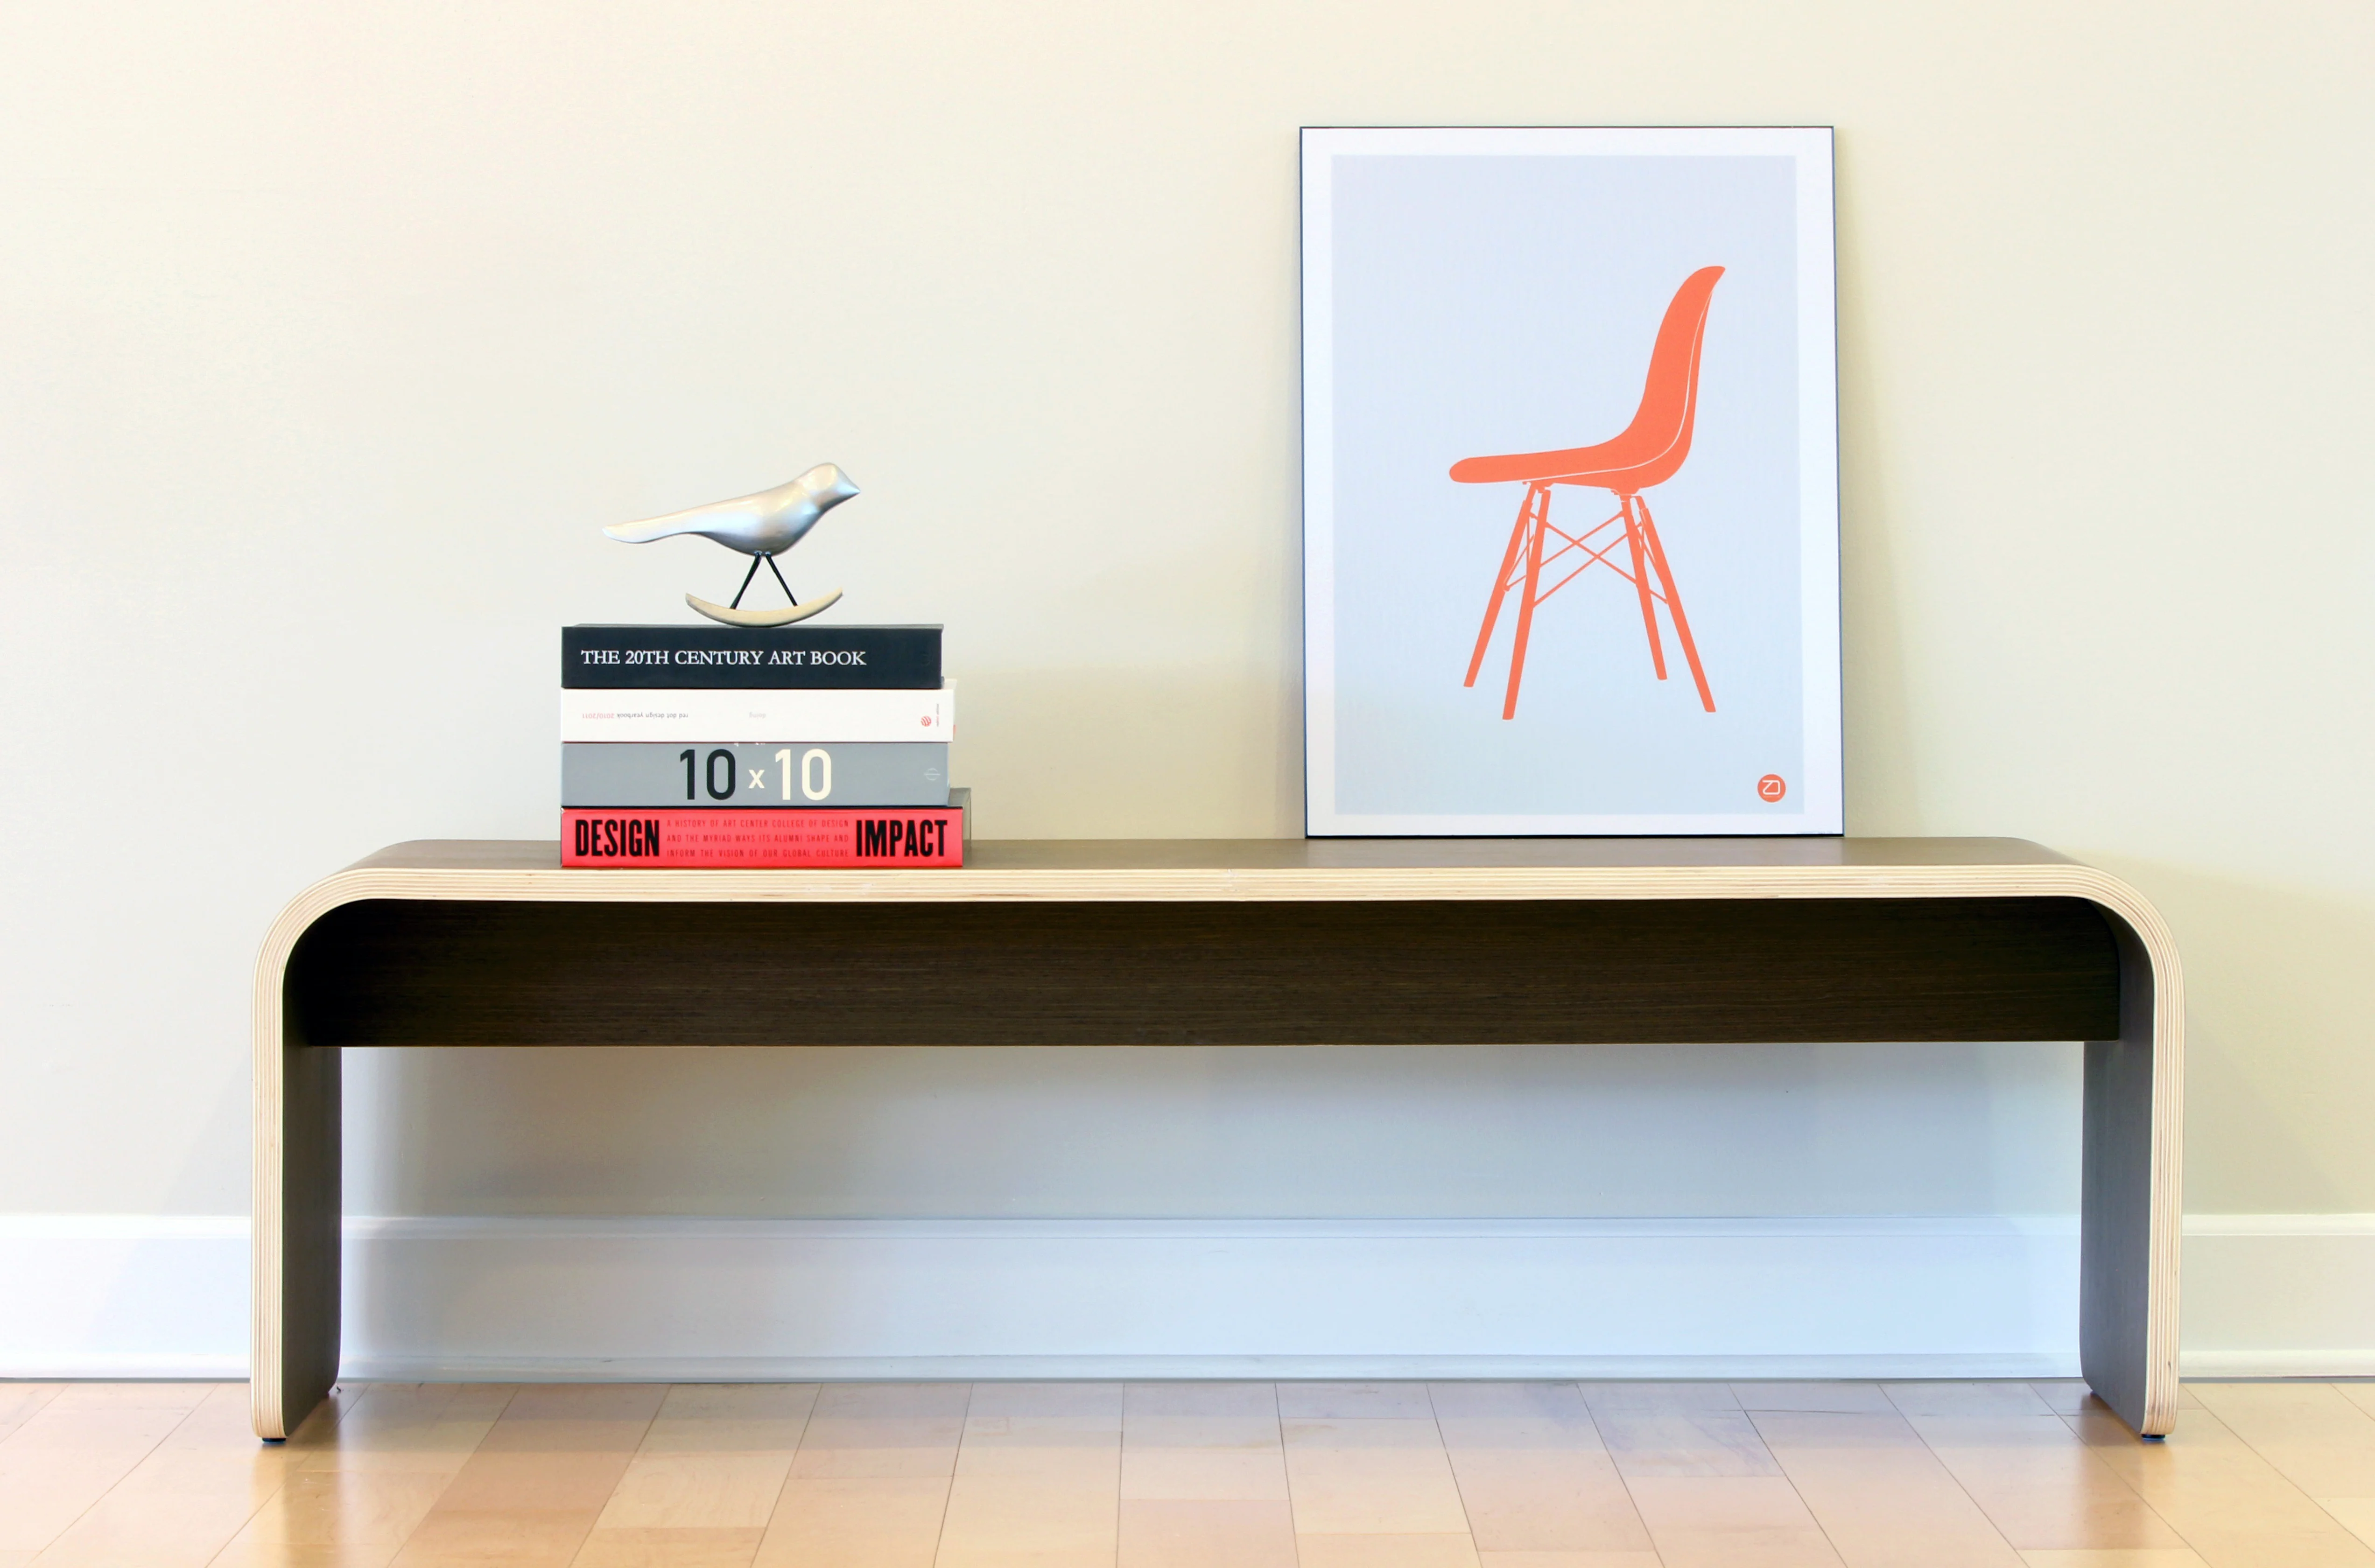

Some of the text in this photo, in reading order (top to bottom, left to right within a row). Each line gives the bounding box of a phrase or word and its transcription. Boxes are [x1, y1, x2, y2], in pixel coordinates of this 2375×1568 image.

[581, 650, 866, 665] THE 20TH CENTURY ART BOOK
[680, 749, 831, 800] 10 x 10
[576, 819, 660, 856] DESIGN
[856, 820, 948, 856] IMPACT
